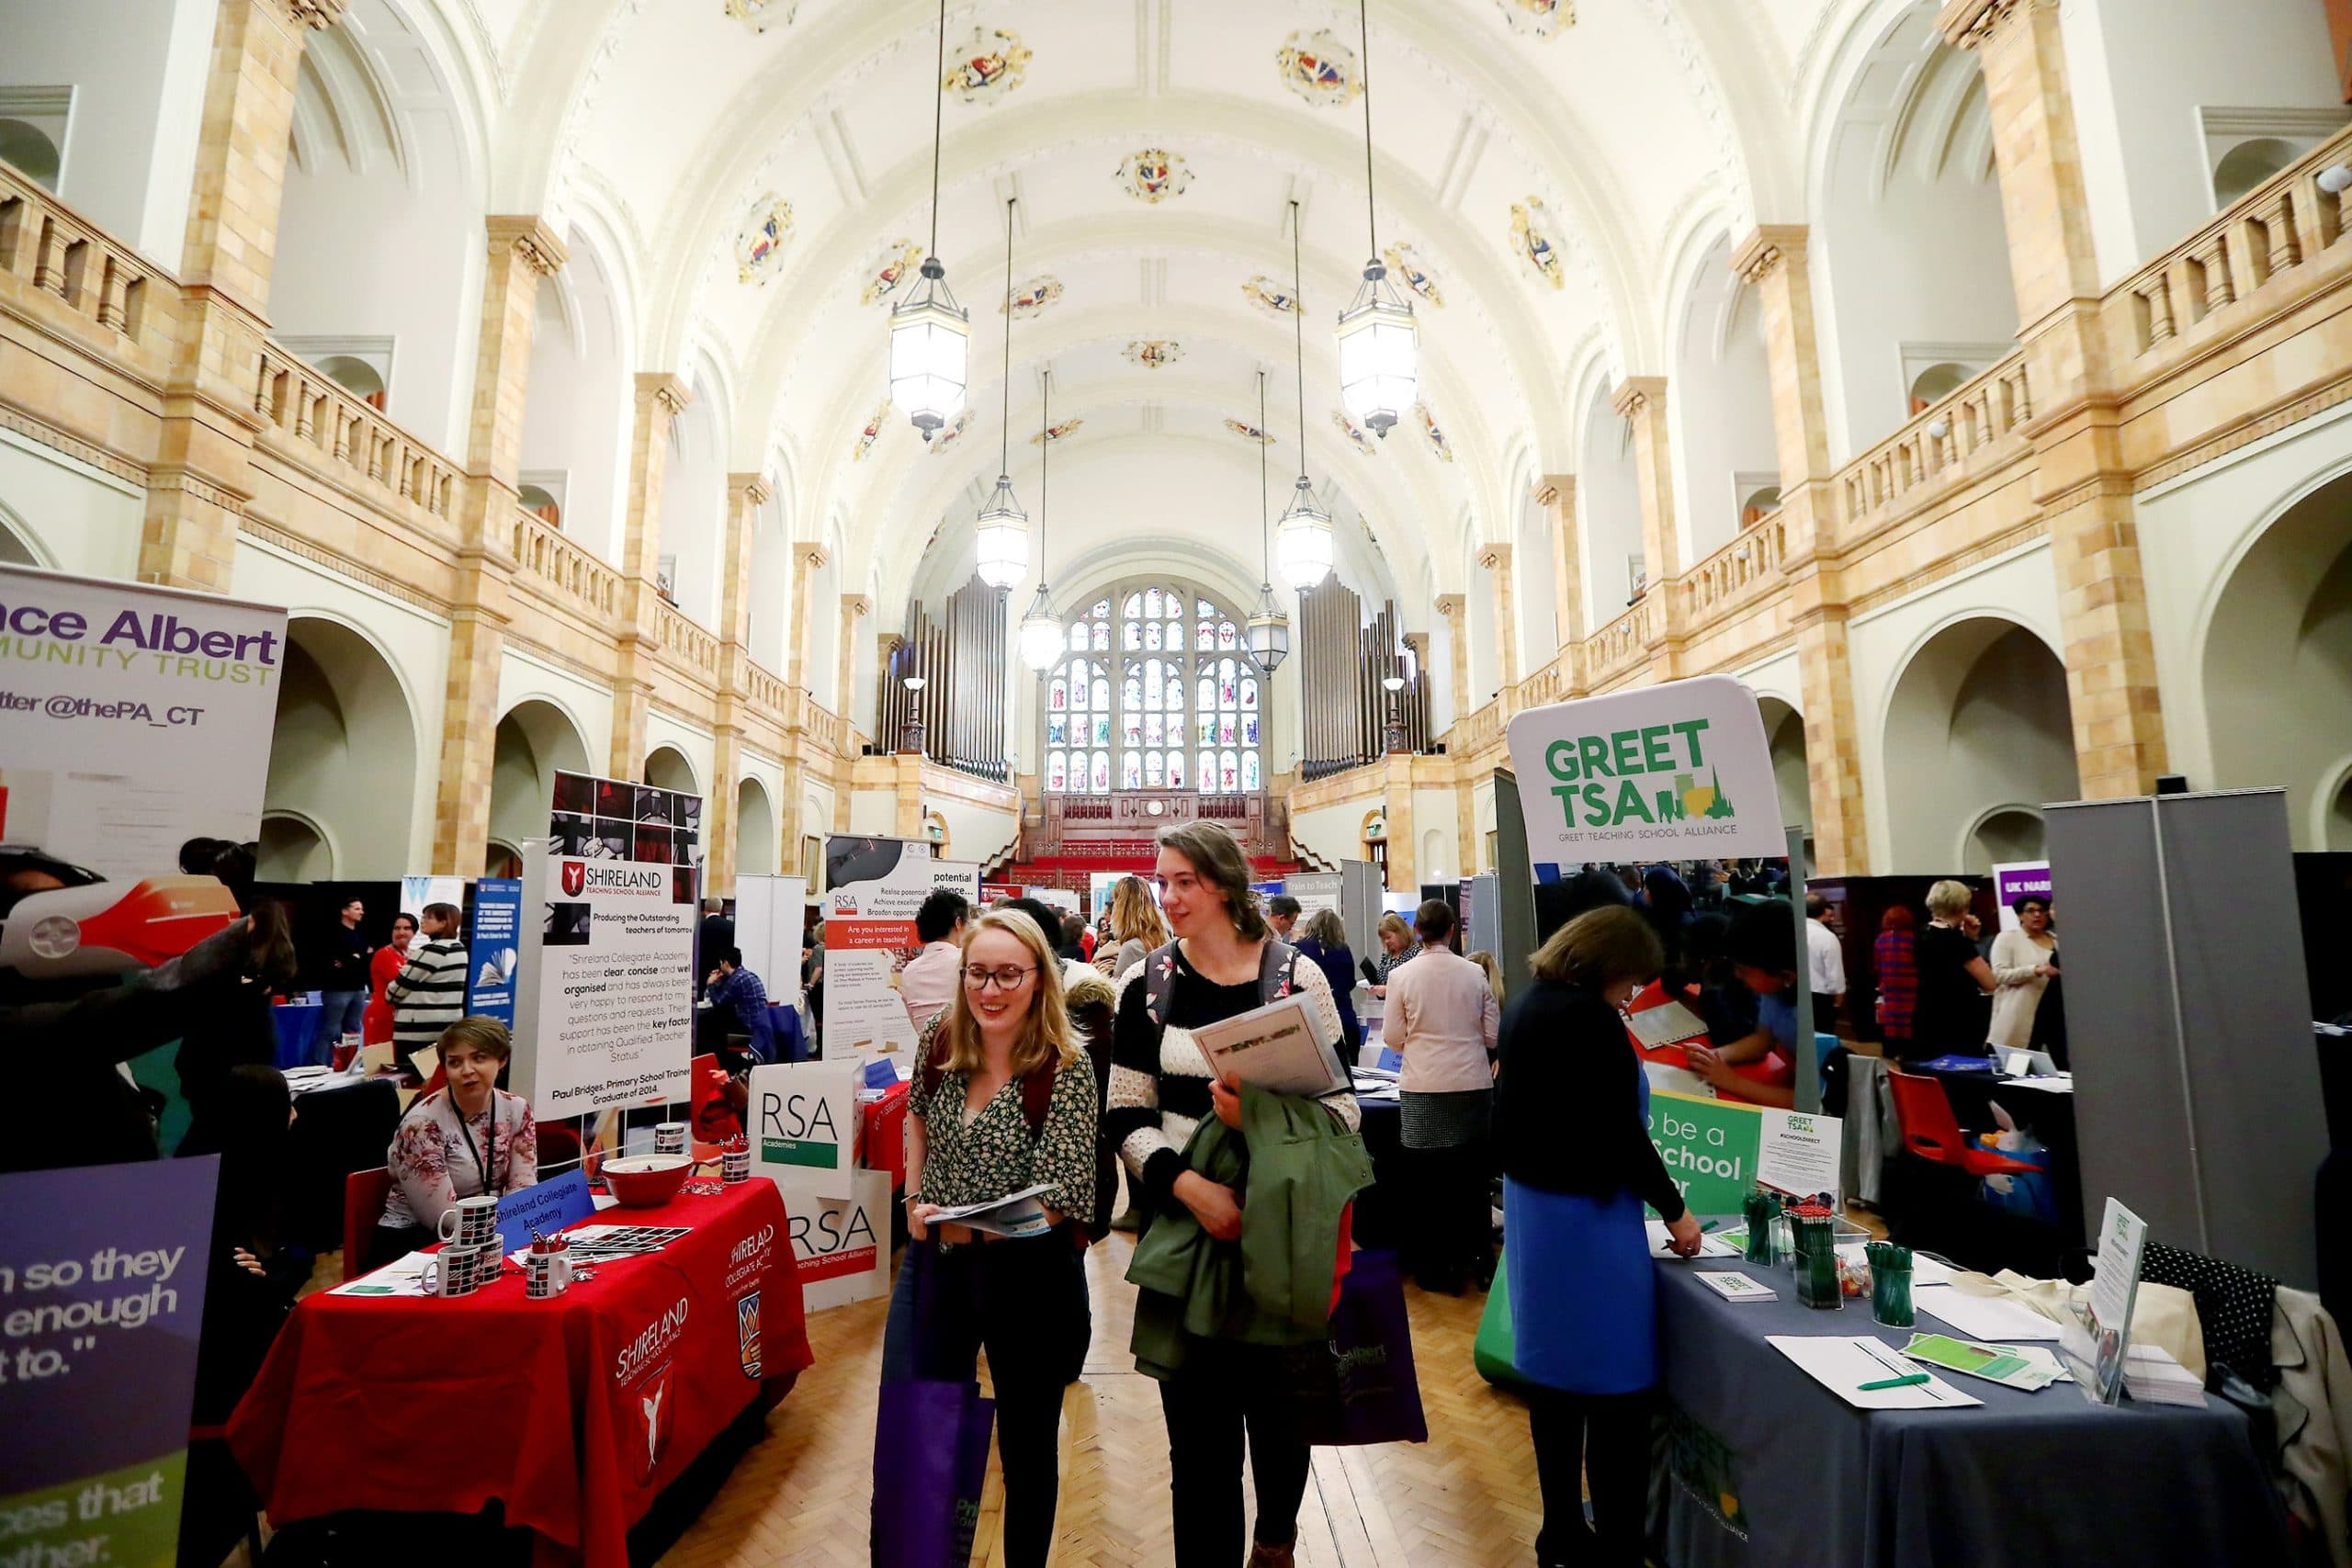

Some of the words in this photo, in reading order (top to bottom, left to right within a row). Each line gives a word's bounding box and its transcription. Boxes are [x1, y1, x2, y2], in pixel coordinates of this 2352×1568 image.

[0, 603, 87, 640] ce
[100, 610, 277, 665] Albert
[154, 654, 274, 686] TRUST
[44, 695, 205, 728] @thePA_CT
[1545, 718, 1710, 782] GREET
[1551, 780, 1655, 828] TSA
[1558, 832, 1584, 842] GREET
[1588, 830, 1634, 841] TEACHING
[1638, 828, 1679, 840] SCHOOL
[1684, 824, 1737, 837] ALLIANCE
[586, 867, 662, 888] SHIRELAND
[933, 873, 972, 883] potential
[1287, 882, 1306, 890] Train
[1306, 882, 1316, 890] to
[1316, 880, 1339, 890] Teach
[586, 886, 613, 895] TEACHING
[2005, 882, 2022, 893] UK
[834, 895, 858, 908] RSA
[594, 912, 626, 924] Producing
[627, 913, 639, 922] the
[639, 913, 680, 924] Outstanding
[656, 926, 664, 934] of
[874, 925, 902, 933] interested
[562, 970, 580, 980] has
[628, 965, 659, 976] concise
[564, 982, 606, 998] organised
[607, 982, 624, 991] and
[609, 1010, 626, 1020] and
[652, 1020, 667, 1030] key
[551, 1088, 573, 1100] Paul
[606, 1077, 639, 1089] Primary
[639, 1072, 665, 1084] School
[593, 1090, 628, 1105] Graduate
[629, 1089, 638, 1098] of
[762, 1092, 838, 1141] RSA
[1787, 1115, 1814, 1125] GREET
[1663, 1112, 1698, 1140] be
[1706, 1128, 1724, 1147] a
[1787, 1122, 1803, 1131] TSA
[763, 1138, 797, 1150] Academies
[496, 1198, 537, 1224] Shireland
[537, 1182, 578, 1205] Collegiate
[523, 1207, 562, 1231] Academy
[787, 1205, 876, 1257] RSA
[821, 1253, 847, 1265] School
[847, 1248, 876, 1259] Alliance
[23, 1260, 84, 1292] so
[90, 1246, 186, 1284] they
[3, 1281, 178, 1329] enough
[616, 1297, 688, 1379] SHIRELAND
[78, 1470, 165, 1521] that
